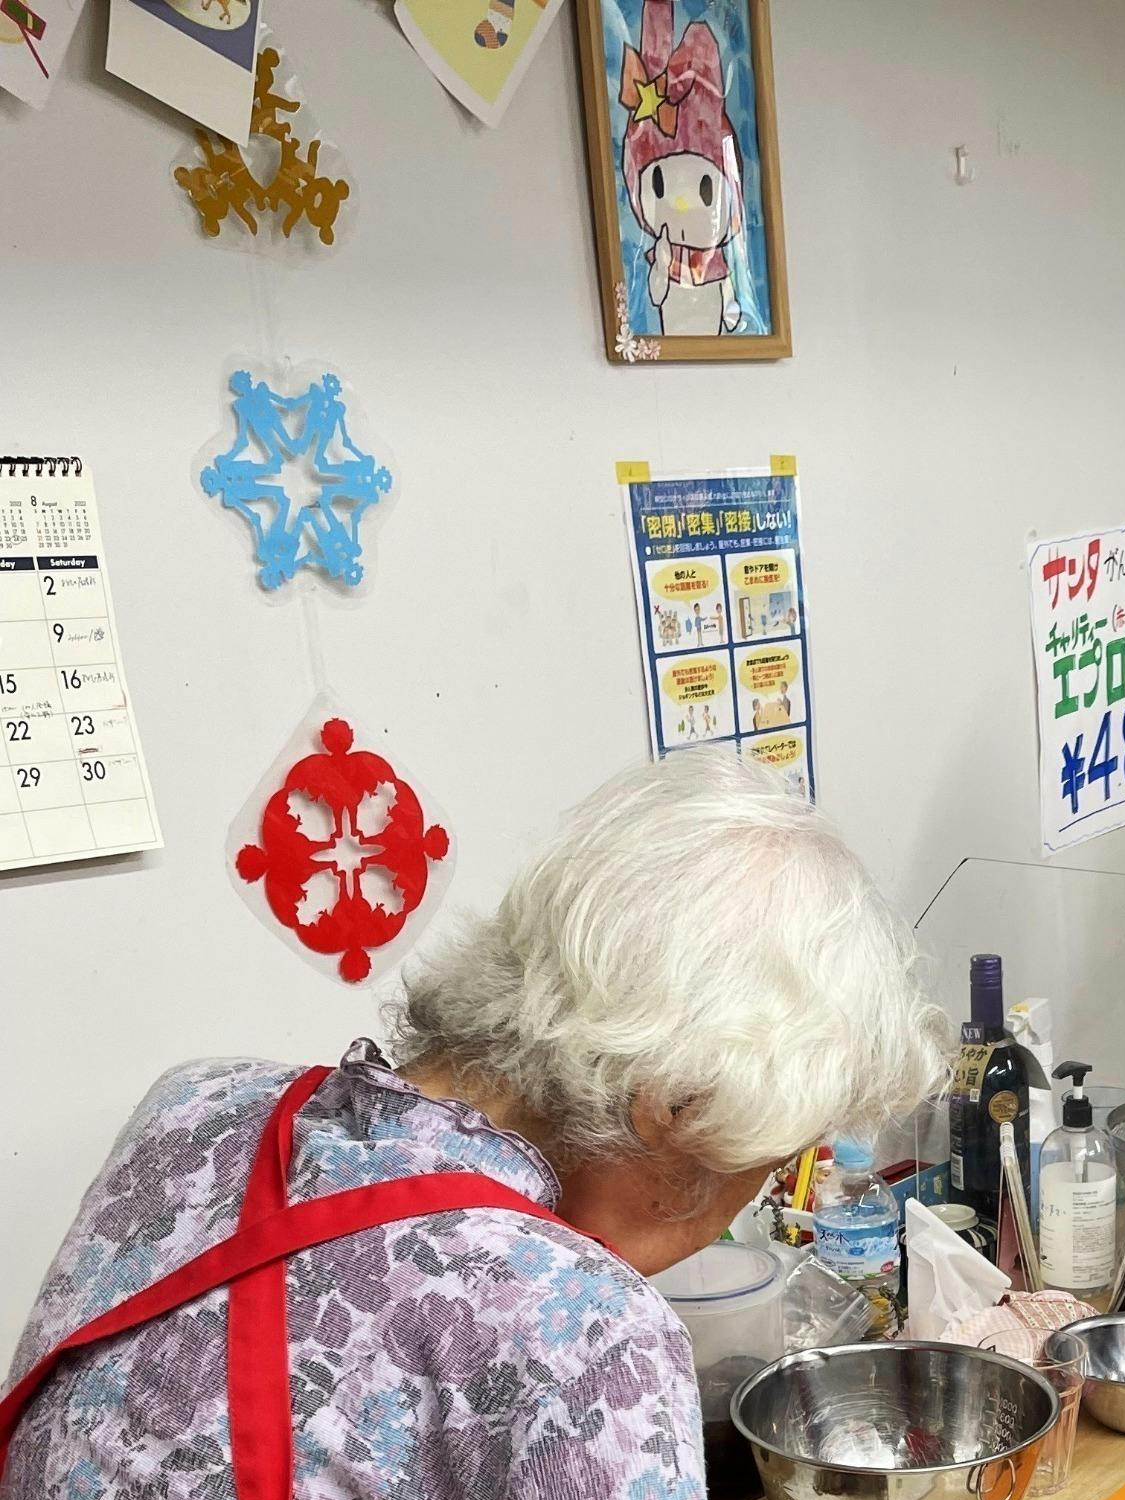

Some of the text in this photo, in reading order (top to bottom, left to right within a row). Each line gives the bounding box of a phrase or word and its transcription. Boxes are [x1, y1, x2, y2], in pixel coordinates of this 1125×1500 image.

[31, 496, 37, 507] 8
[50, 558, 85, 567] Saturday
[43, 576, 56, 595] 2
[53, 623, 64, 643] 9
[1045, 612, 1108, 658] チャリティー
[0, 674, 17, 694] 15
[61, 669, 82, 689] 16
[6, 721, 31, 741] 22
[71, 715, 95, 735] 23
[17, 767, 40, 788] 29
[82, 761, 106, 781] 30
[962, 1026, 982, 1040] NEW
